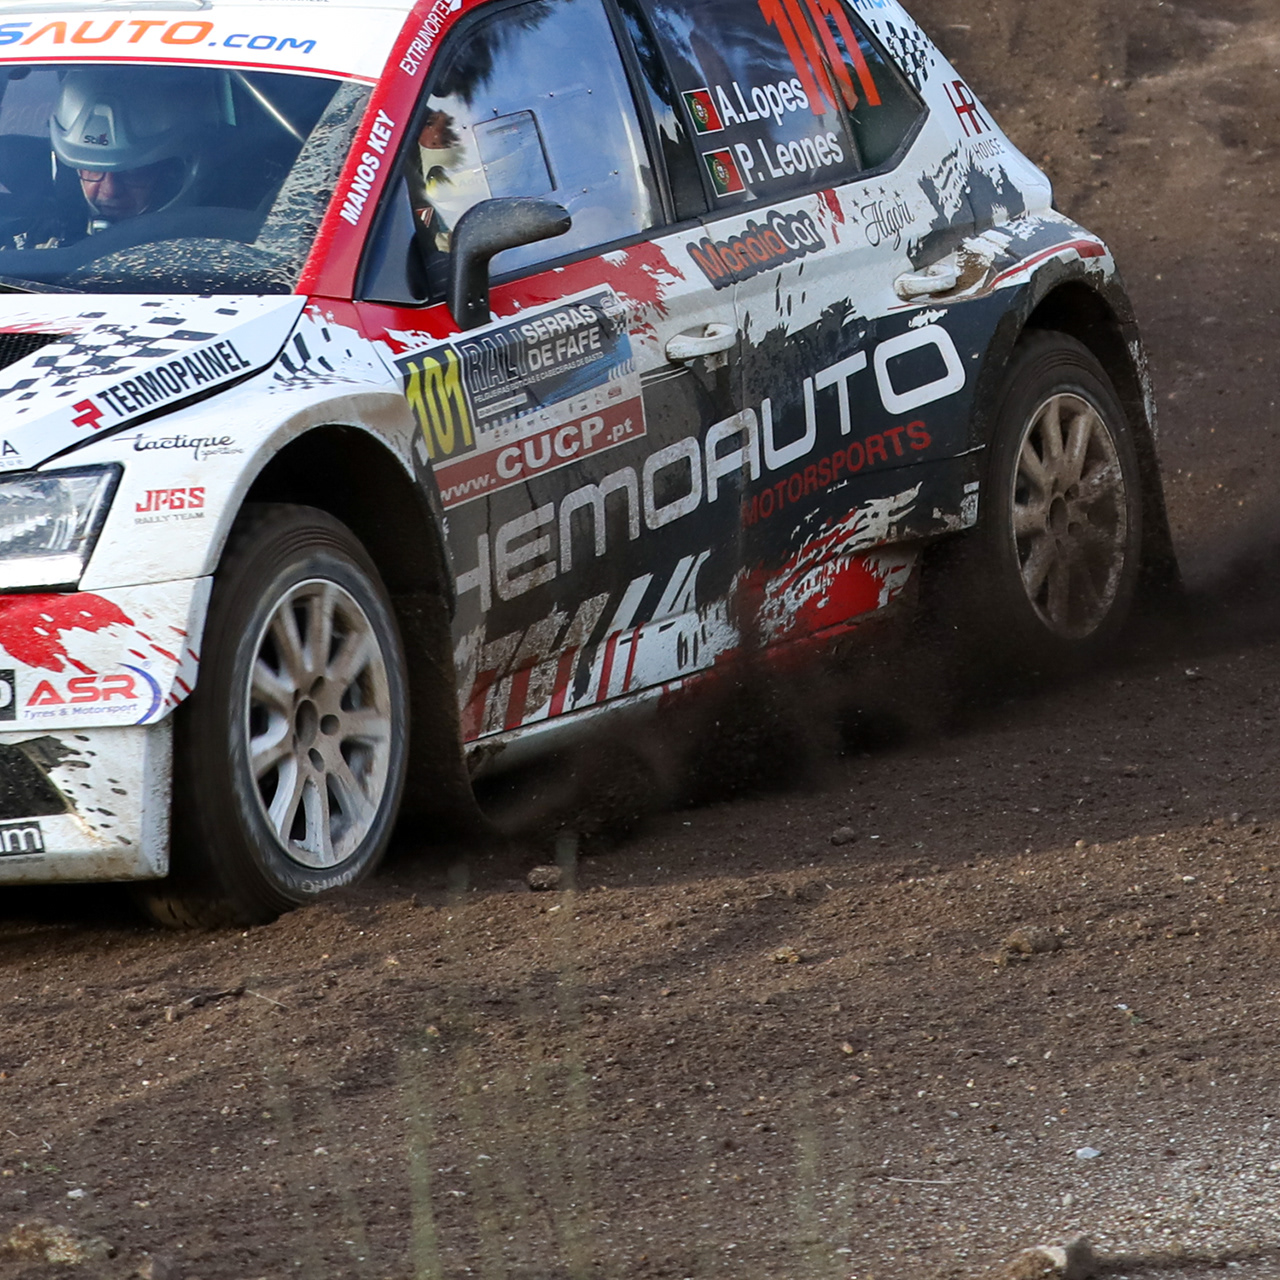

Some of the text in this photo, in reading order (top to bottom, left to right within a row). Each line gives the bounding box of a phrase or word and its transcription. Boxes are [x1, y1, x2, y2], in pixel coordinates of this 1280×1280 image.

[715, 77, 809, 127] A.Lopes
[340, 108, 396, 226] MANOS KEY
[734, 131, 845, 184] P. Leones
[971, 137, 1006, 161] HOUSE
[462, 328, 526, 395] RALI
[520, 304, 598, 345] SERRAS
[528, 326, 602, 372] DE FAFE
[95, 339, 252, 417] TERMOPAINEL
[404, 349, 473, 460] 101
[120, 433, 236, 461] tactique
[742, 420, 932, 528] MOTORSPORTS
[134, 512, 205, 525] RALLY TEAM
[24, 703, 138, 719] Tyres & Motorsport
[26, 674, 139, 706] ASR
